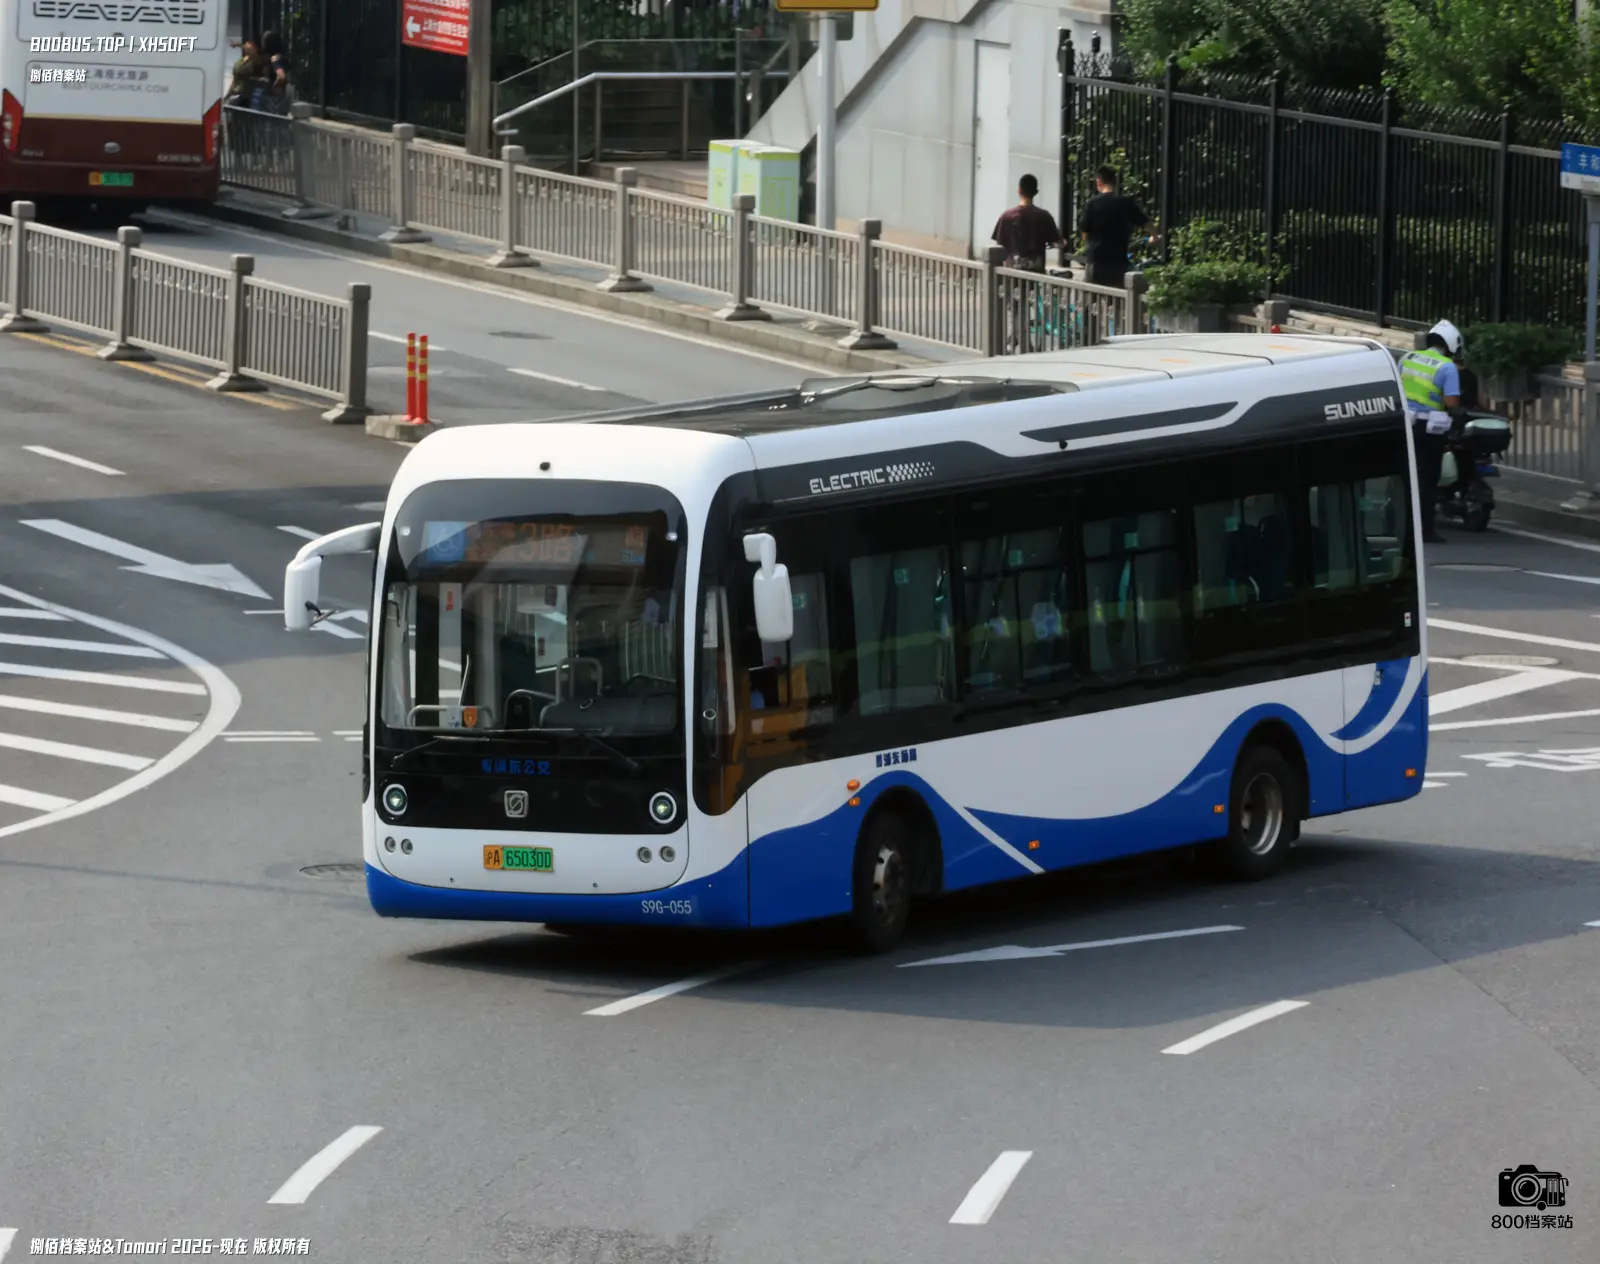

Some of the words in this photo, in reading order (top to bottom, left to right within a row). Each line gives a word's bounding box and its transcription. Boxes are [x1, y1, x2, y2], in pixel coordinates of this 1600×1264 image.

[1324, 396, 1396, 421] SUNWIN
[809, 468, 886, 494] ELECTRIC
[641, 900, 692, 915] S9G-055
